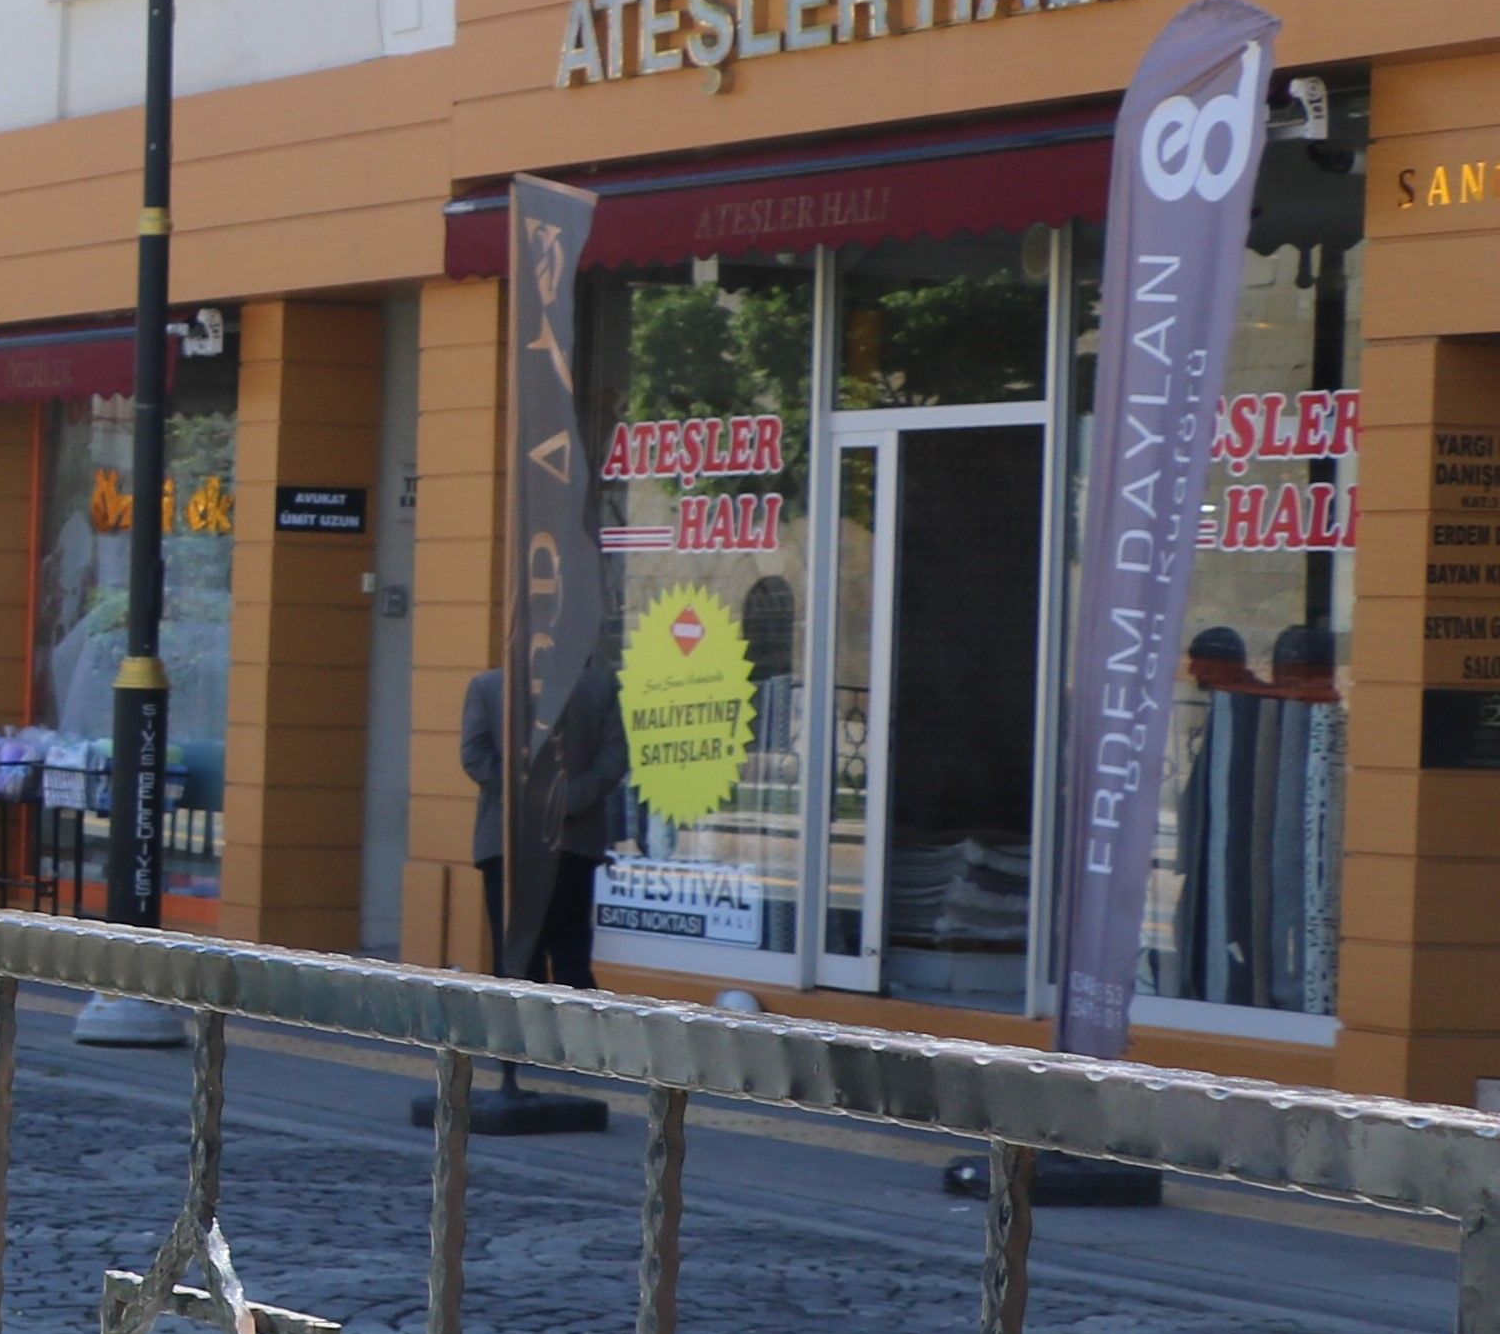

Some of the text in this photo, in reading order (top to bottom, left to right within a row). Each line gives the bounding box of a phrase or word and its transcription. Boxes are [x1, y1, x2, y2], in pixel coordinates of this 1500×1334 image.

[1397, 161, 1500, 209] SAN
[695, 186, 892, 243] ATEŞLER HALI
[1115, 255, 1182, 573] DAYLAN
[602, 414, 784, 489] ATEŞLER
[294, 493, 347, 506] AVUKAT
[319, 515, 361, 528] UZUN
[677, 493, 783, 553] HALI
[1434, 525, 1491, 546] ERDEM
[1427, 564, 1480, 585] BAYAN
